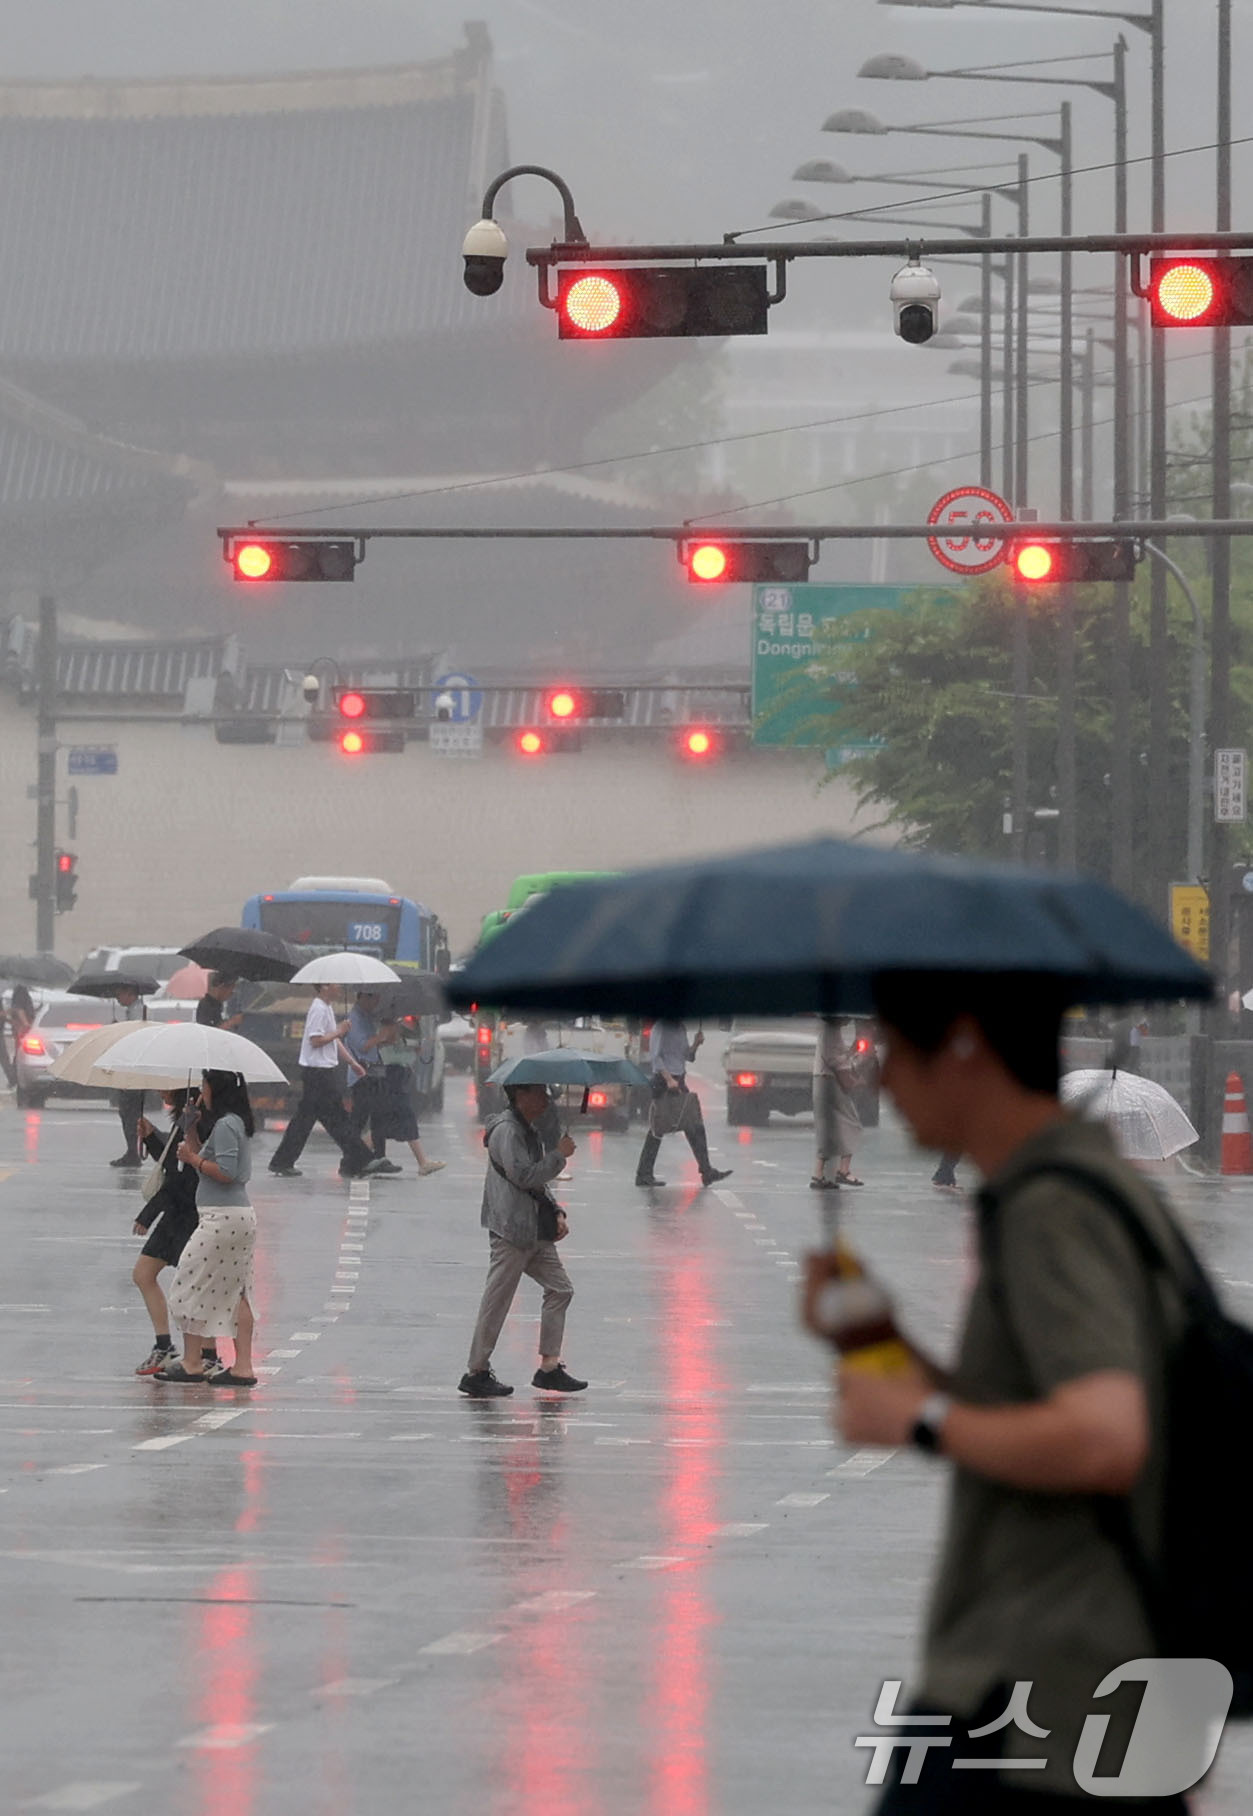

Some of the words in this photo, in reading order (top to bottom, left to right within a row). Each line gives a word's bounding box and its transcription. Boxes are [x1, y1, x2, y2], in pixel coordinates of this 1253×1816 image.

[945, 510, 995, 551] 50
[768, 591, 788, 609] 21
[758, 612, 816, 637] 독립문
[353, 924, 382, 941] 708
